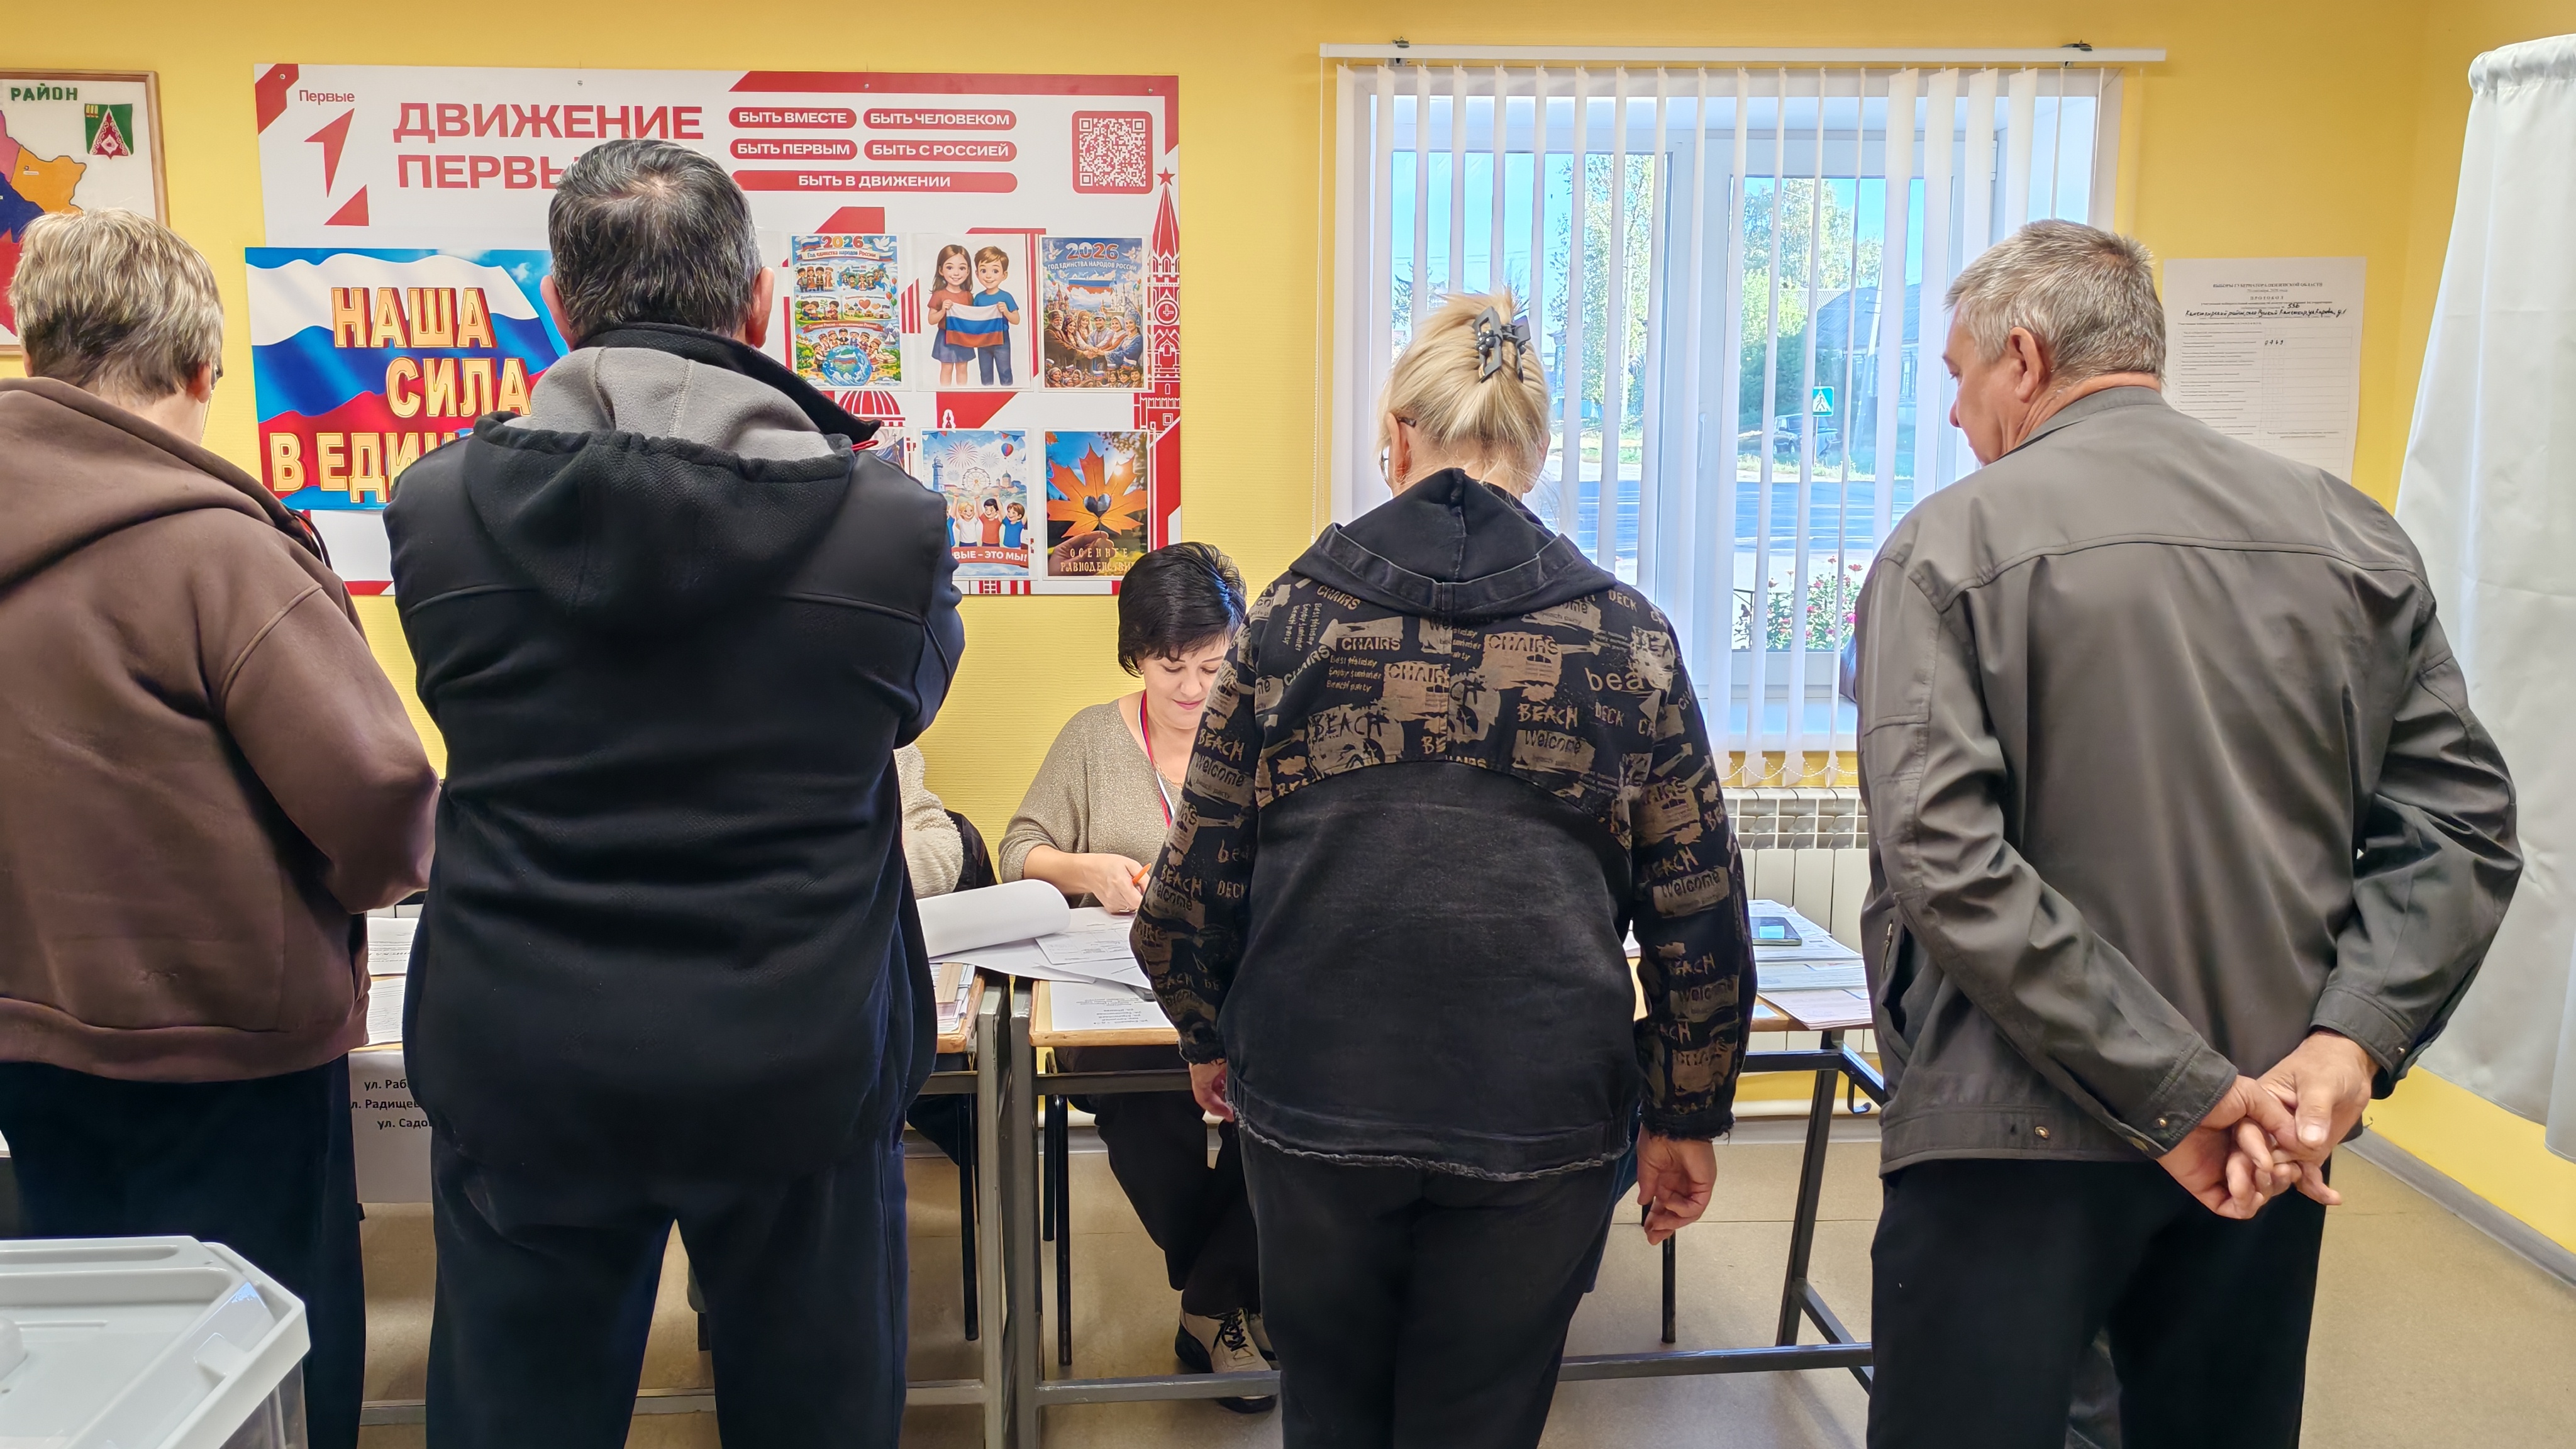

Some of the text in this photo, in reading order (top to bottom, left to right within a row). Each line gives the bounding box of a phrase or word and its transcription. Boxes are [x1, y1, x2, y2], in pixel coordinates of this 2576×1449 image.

[11, 82, 79, 101] РАЙОН
[299, 89, 355, 104] Первые
[393, 103, 704, 144] ДВИЖЕНИЕ
[739, 112, 847, 124] БЫТЬ ВМЕСТЕ
[870, 113, 1010, 126] БЫТЬ ЧЕЛОВЕКОМ
[737, 143, 850, 155] БЫТЬ ПЕРВЫМ
[872, 142, 1009, 157] БЫТЬ С РОССИЕЙ
[799, 175, 951, 189] БЫТЬ В ДВИЖЕНИИ
[821, 235, 864, 248] 2026
[1065, 242, 1119, 260] 2026
[1116, 263, 1137, 271] РОССИИ
[331, 287, 499, 349] НАША
[386, 356, 533, 419] СИЛА
[270, 432, 457, 503] В ЕДИ
[952, 550, 977, 560] ВЫЕ
[984, 550, 1004, 559] ЭТО
[1005, 552, 1028, 562] МЫ!
[1317, 585, 1361, 610] CHAIRS
[1608, 589, 1638, 612] DECK
[1341, 637, 1402, 651] CHAIRS
[1488, 635, 1560, 655] CHAIRS
[1284, 645, 1330, 686] CHAIRS
[1516, 702, 1579, 730] BEACH
[1595, 701, 1625, 728] DECK
[1197, 728, 1245, 762] BEACH
[1524, 730, 1582, 755] Welcome
[1194, 754, 1245, 787] Welcome
[1160, 863, 1202, 899] BEACH
[1662, 869, 1720, 898] Welcome
[364, 1082, 382, 1091] ул.
[377, 1121, 396, 1130] ул.
